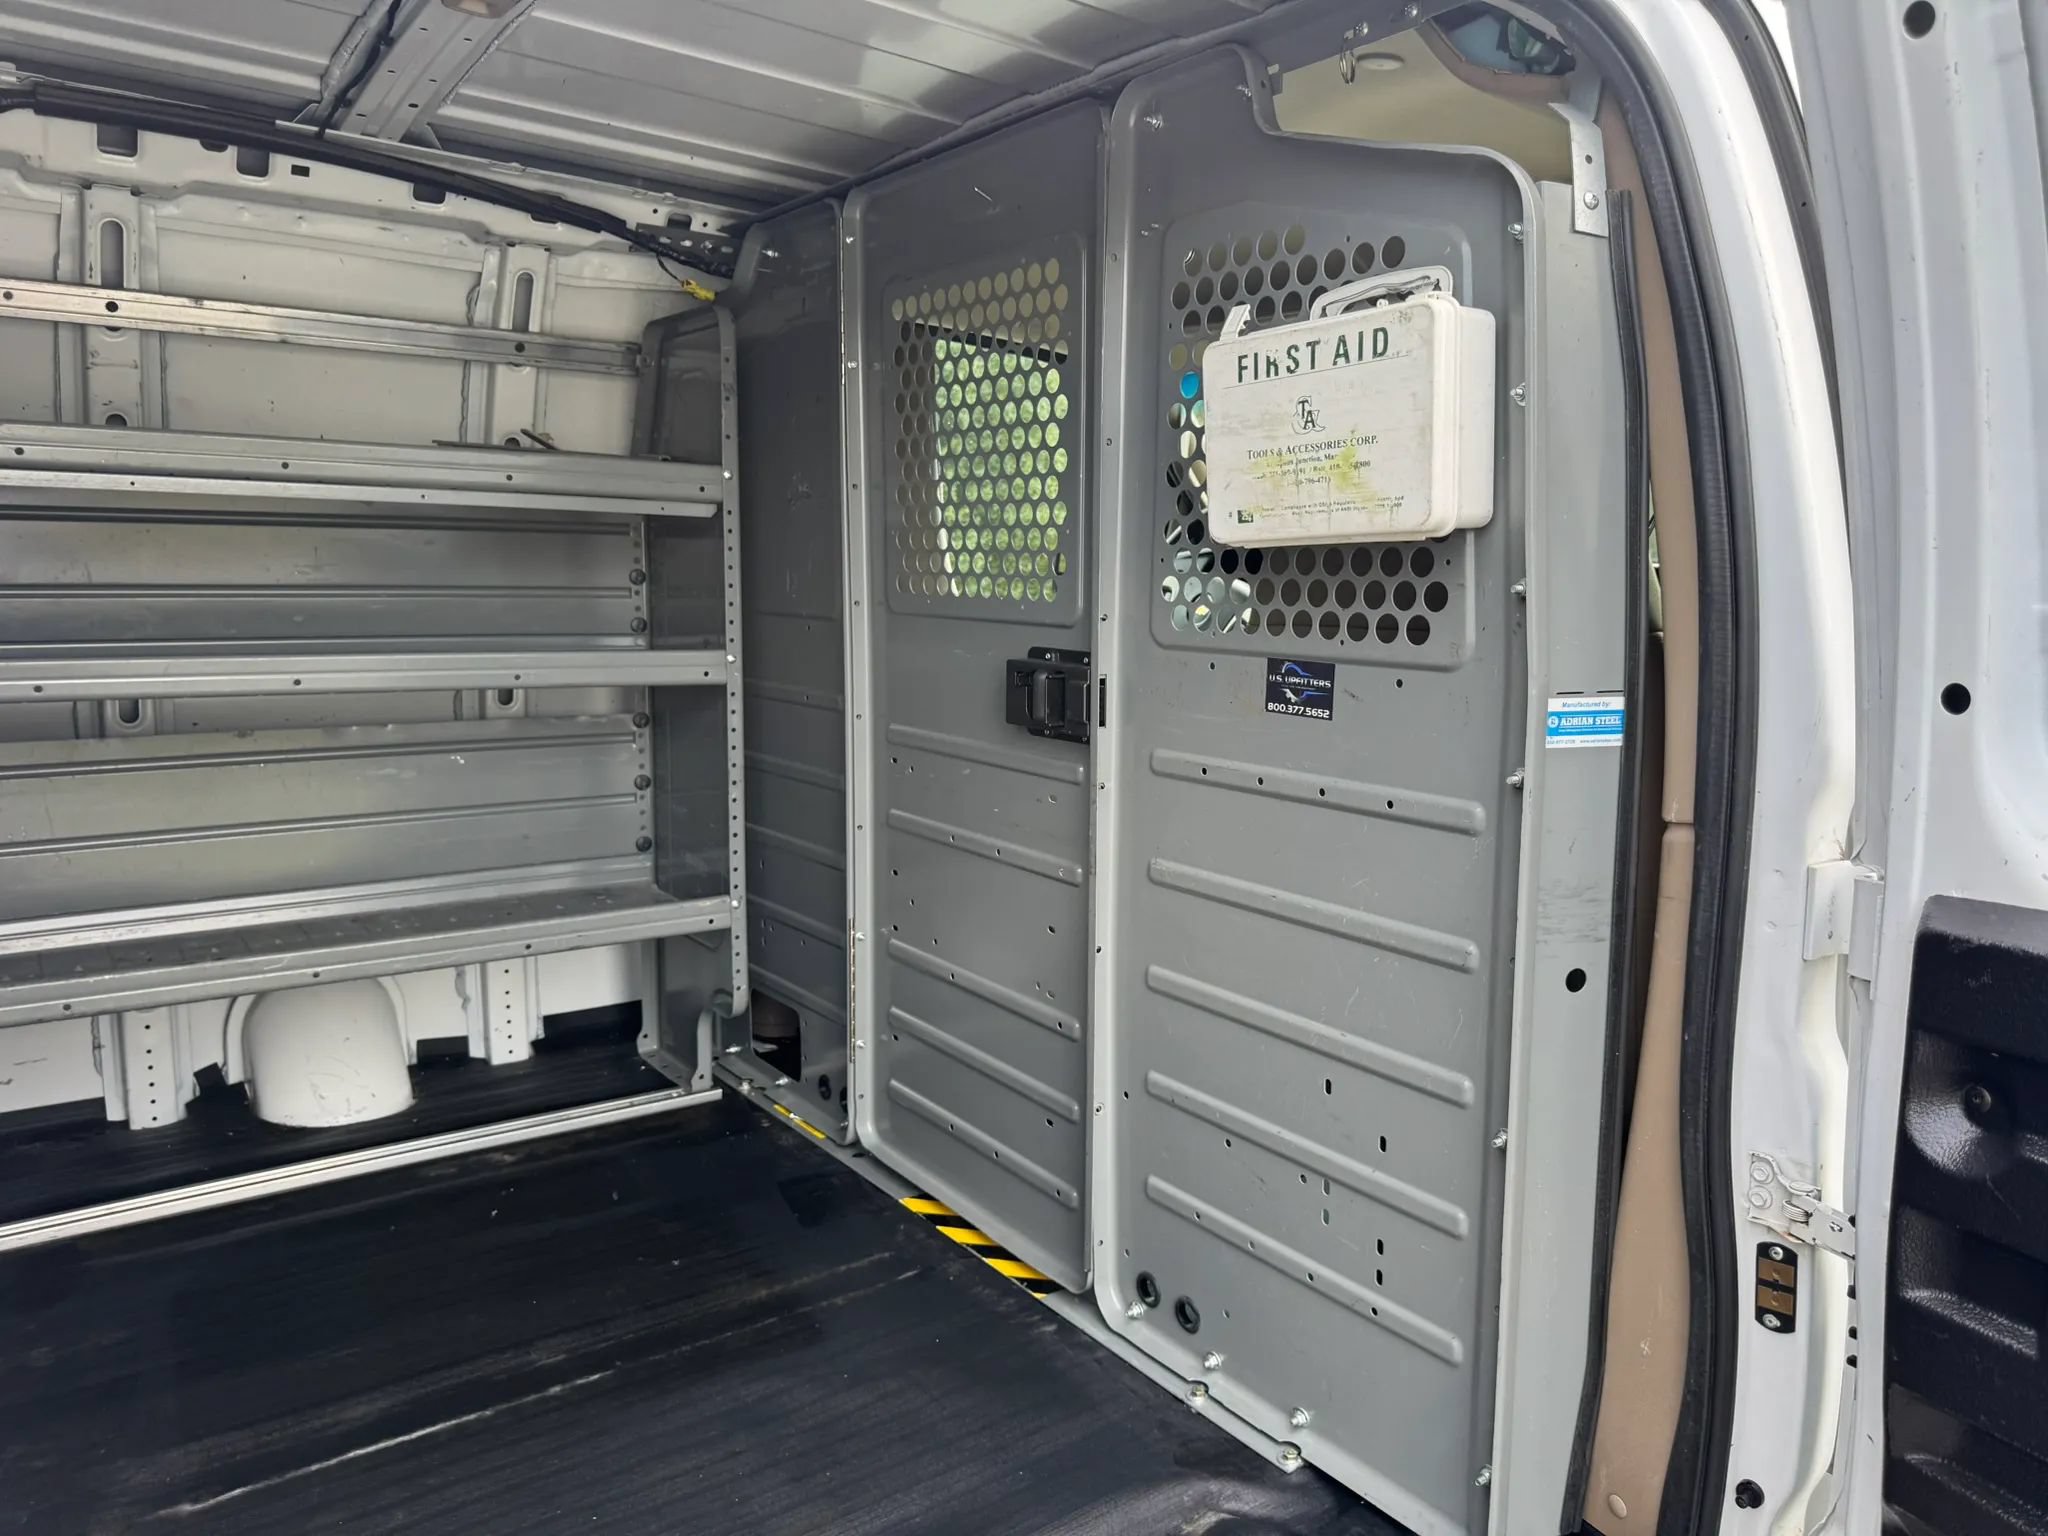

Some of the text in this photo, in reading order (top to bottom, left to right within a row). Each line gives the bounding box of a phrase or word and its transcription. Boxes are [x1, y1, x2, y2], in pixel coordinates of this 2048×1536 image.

[1237, 326, 1390, 384] FIRST AID
[1285, 438, 1349, 455] ACCESSORIES
[1350, 434, 1379, 447] CORP.
[1285, 676, 1332, 689] UPFITTERS
[1267, 702, 1330, 719] 800.377.5652
[1560, 715, 1621, 726] ADRIAN STEEL
